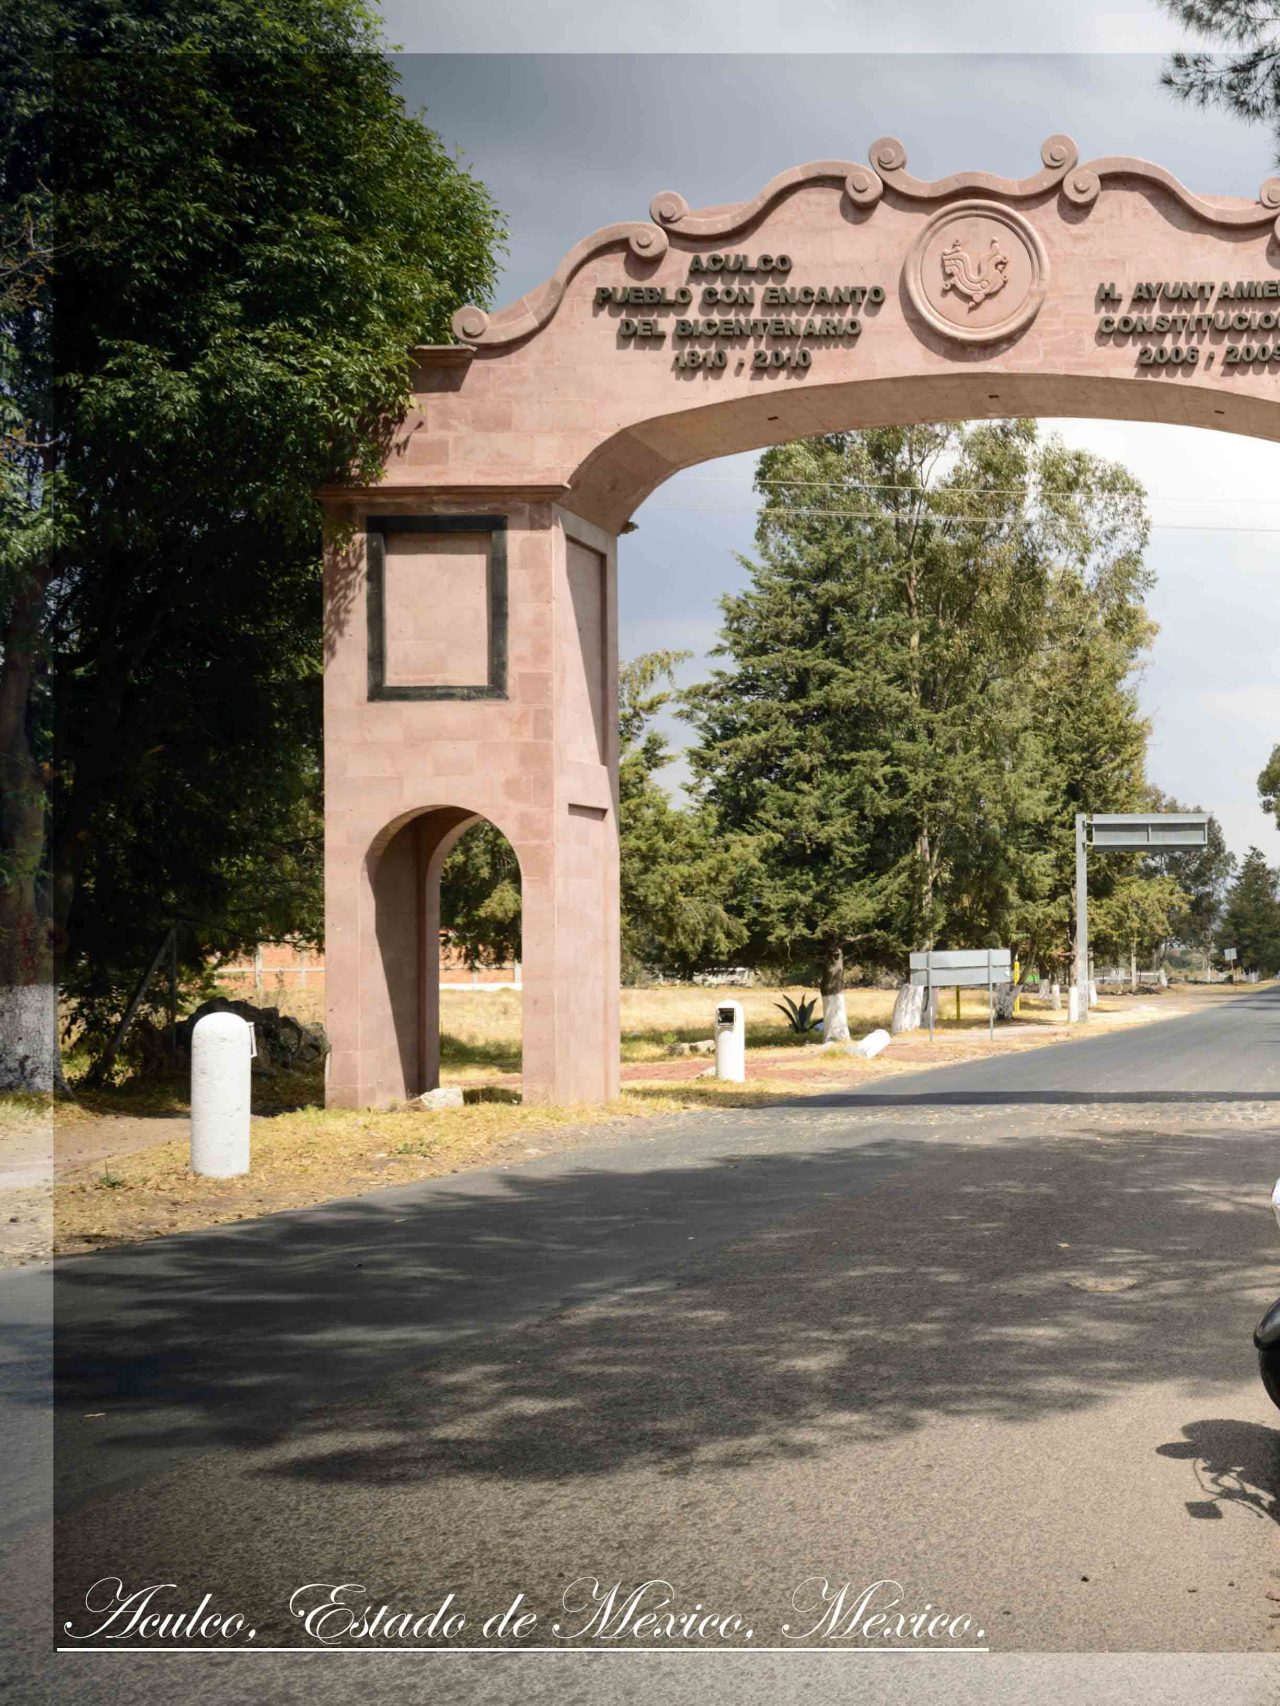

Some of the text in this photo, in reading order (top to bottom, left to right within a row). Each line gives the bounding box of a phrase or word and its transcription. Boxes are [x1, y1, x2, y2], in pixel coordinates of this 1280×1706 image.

[689, 254, 793, 274] ACULCO
[596, 285, 886, 306] PUEBLO CON ENCANTO
[1098, 281, 1123, 300] H.
[618, 318, 862, 339] DEL BICENTENARIO
[675, 350, 728, 369] 1810
[754, 349, 812, 369] 2010
[1139, 345, 1200, 365] 2006
